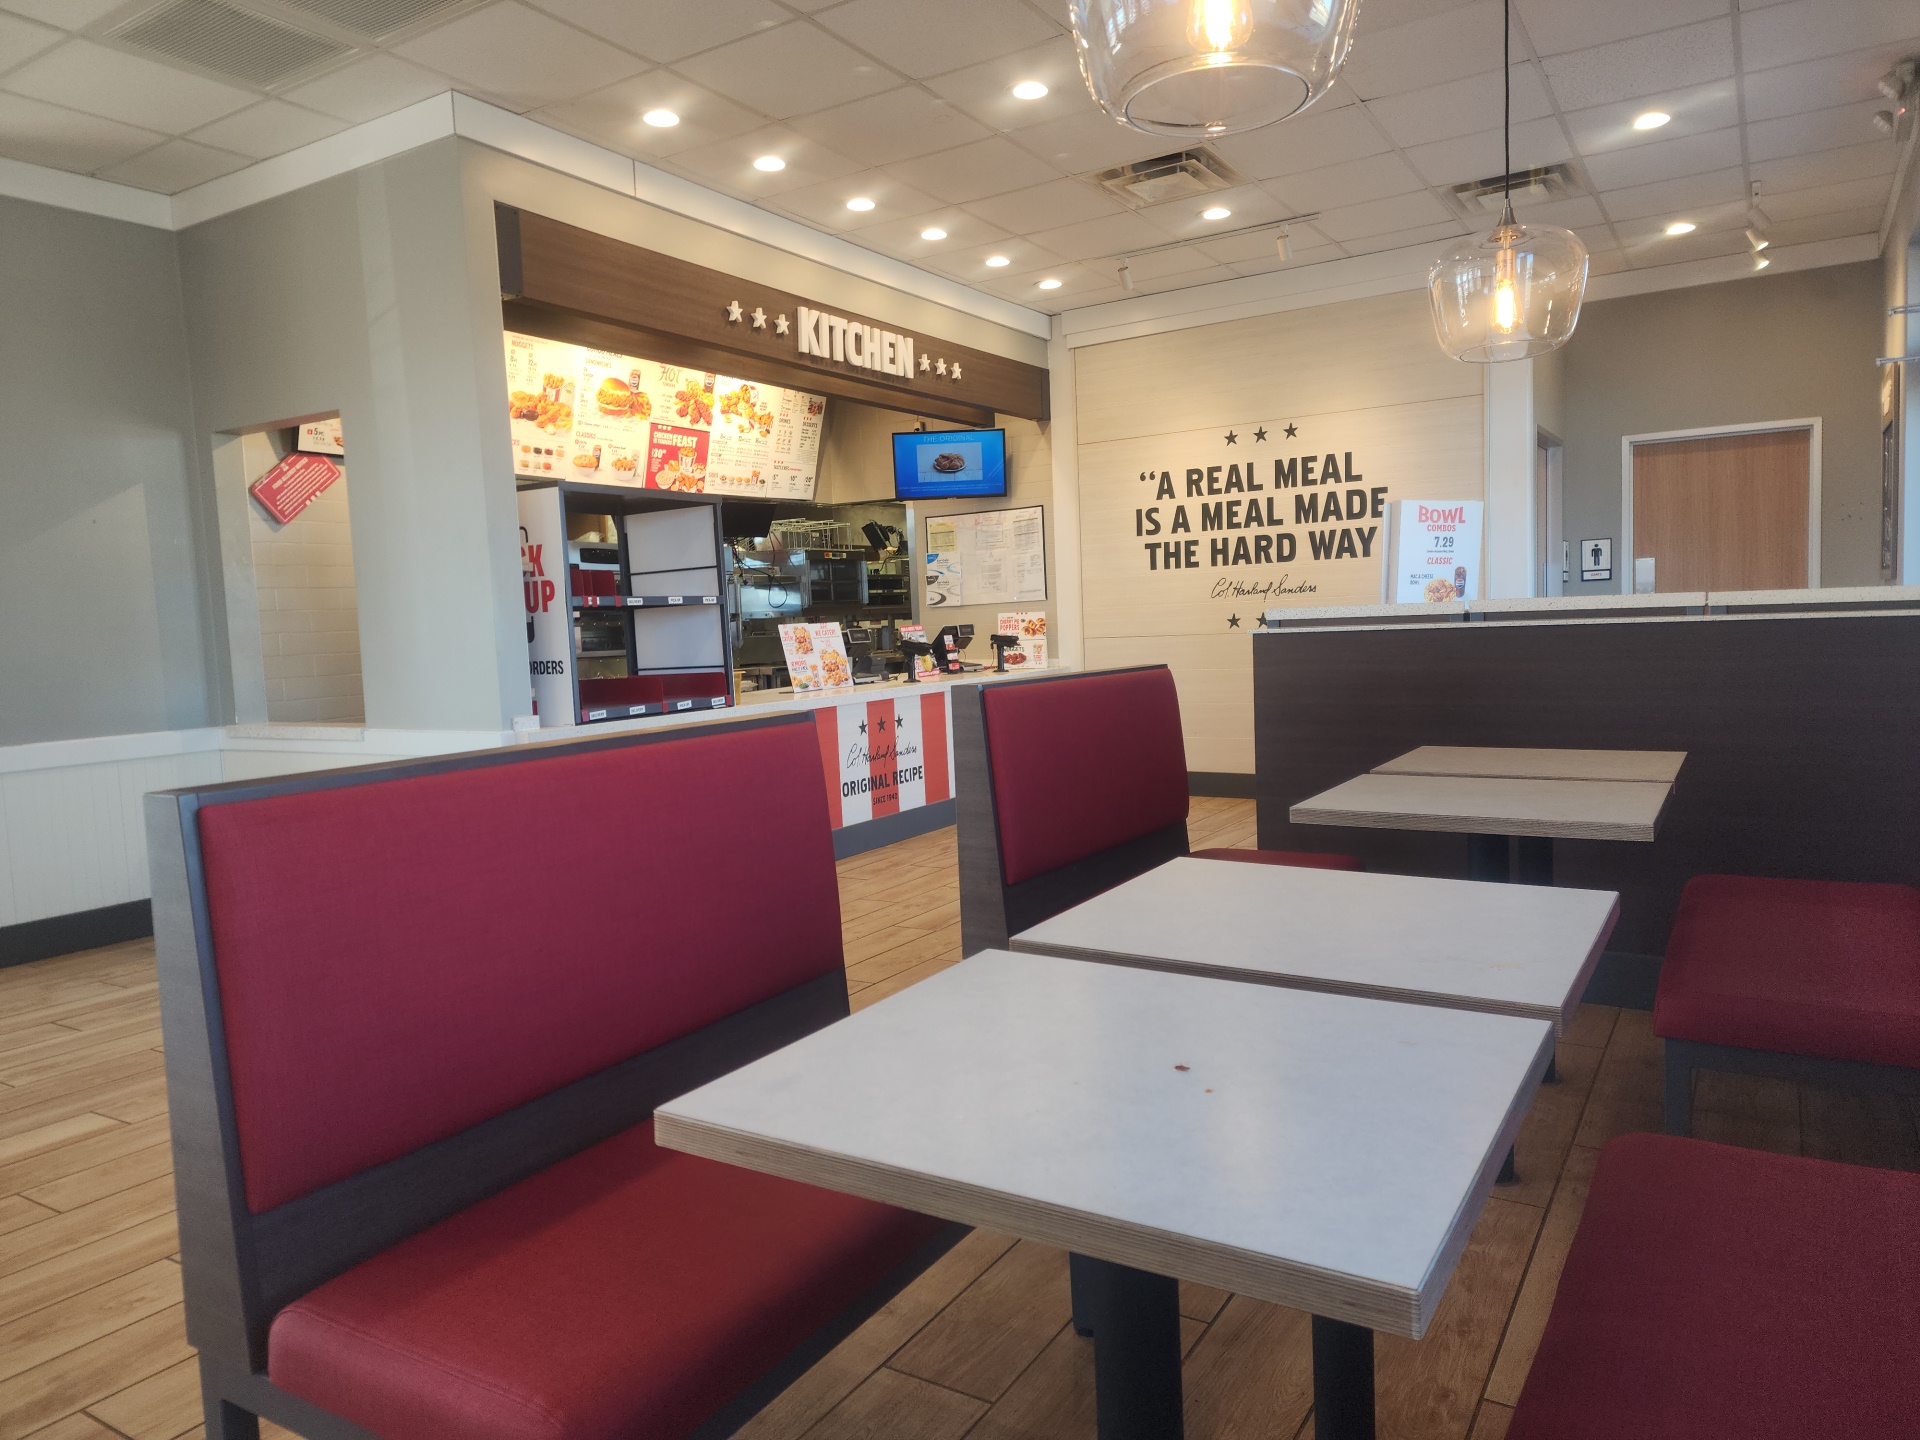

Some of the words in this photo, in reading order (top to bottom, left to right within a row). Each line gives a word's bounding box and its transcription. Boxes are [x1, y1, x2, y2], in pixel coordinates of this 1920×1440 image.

[797, 306, 914, 379] KITCHEN
[659, 364, 683, 384] HOT
[672, 433, 698, 448] FEAST
[923, 435, 938, 443] THE
[940, 434, 974, 442] ORIGINAL
[1186, 462, 1264, 498] REAL
[1274, 452, 1362, 490] MEAL
[1136, 507, 1162, 536] IS
[1171, 504, 1191, 534] A
[1201, 496, 1284, 532] MEAL
[1294, 486, 1388, 525] MADE
[1418, 504, 1466, 524] BOWL
[1144, 540, 1200, 570] THE
[1210, 532, 1297, 566] HARD
[1308, 526, 1378, 560] WAY
[1434, 536, 1454, 548] 7.29
[1426, 557, 1453, 565] CLASSIC
[524, 580, 556, 614] UP
[842, 773, 890, 798] ORIGINAL
[892, 765, 924, 786] RECIPE
[872, 795, 886, 806] SINCE
